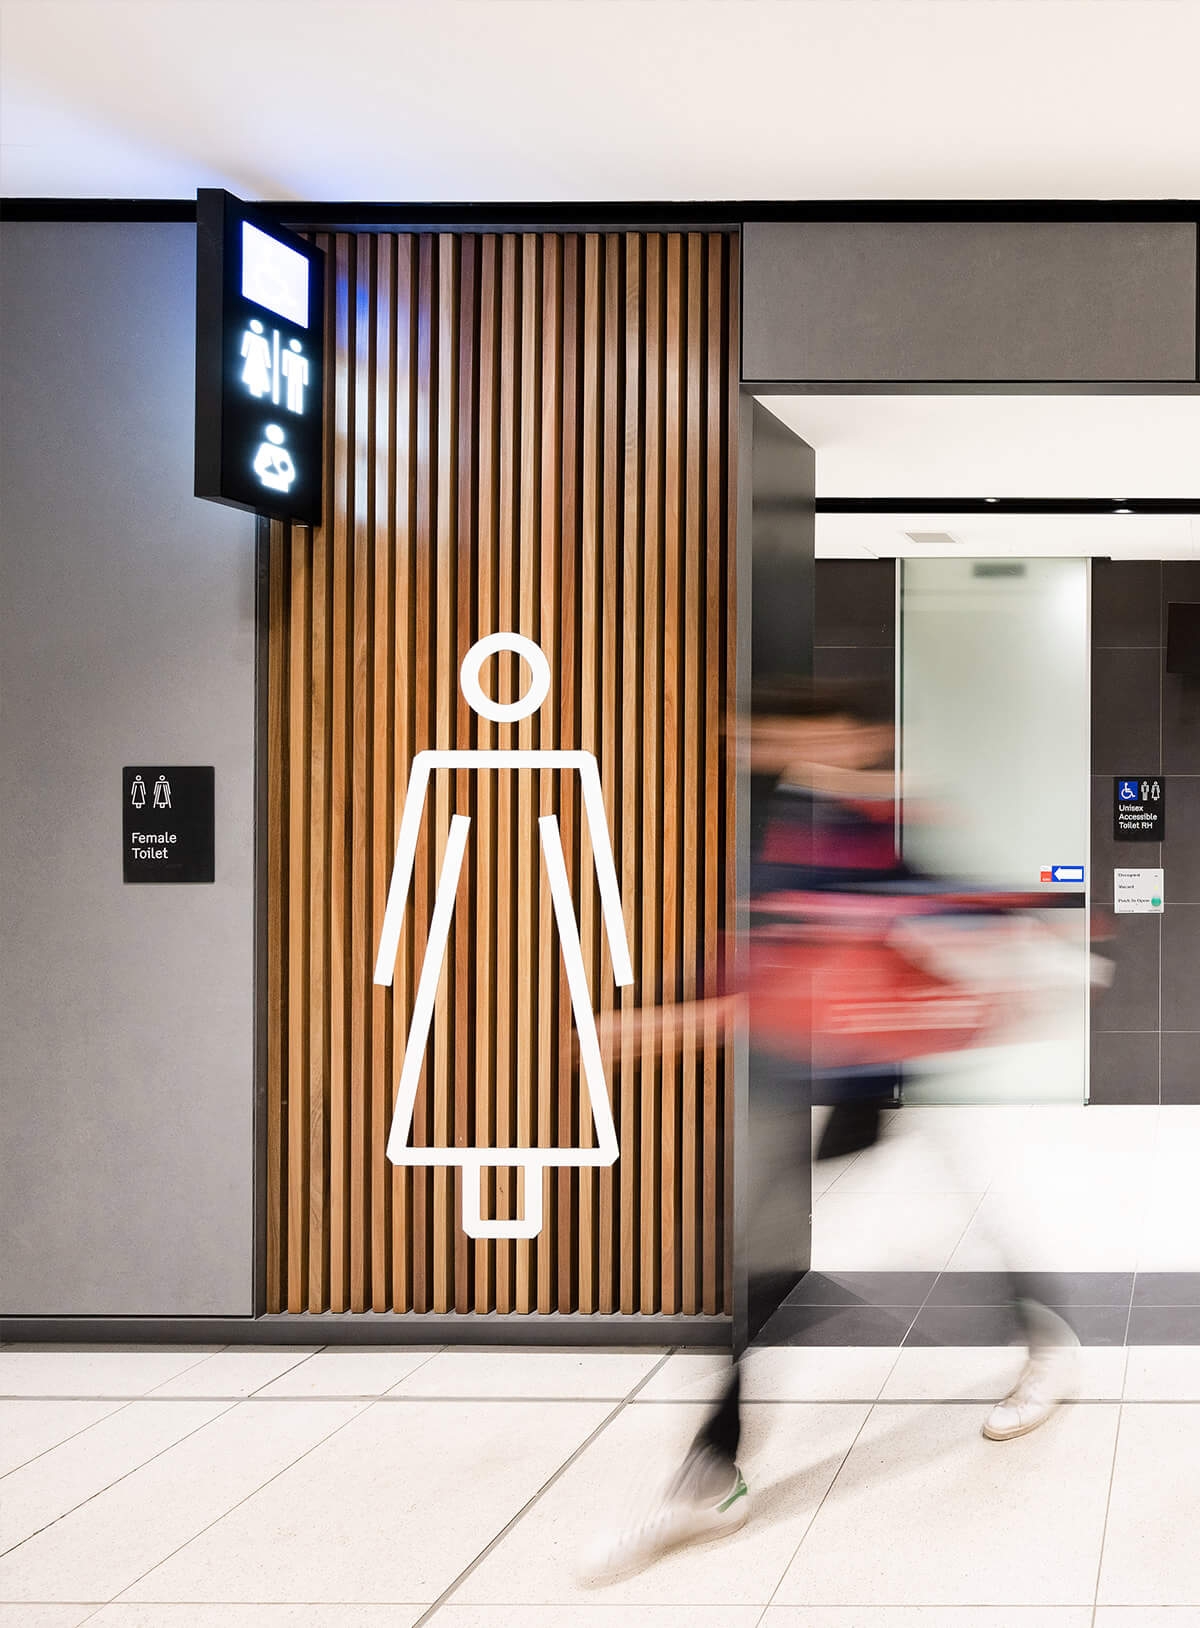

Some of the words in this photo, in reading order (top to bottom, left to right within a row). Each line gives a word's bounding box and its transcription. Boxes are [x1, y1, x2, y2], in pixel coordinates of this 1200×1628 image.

[1118, 804, 1144, 812] Unisex
[1118, 812, 1158, 821] Accessible
[1118, 821, 1140, 829] Toilet
[1141, 821, 1153, 829] RH
[131, 831, 178, 844] Female
[131, 847, 169, 860] Toilet
